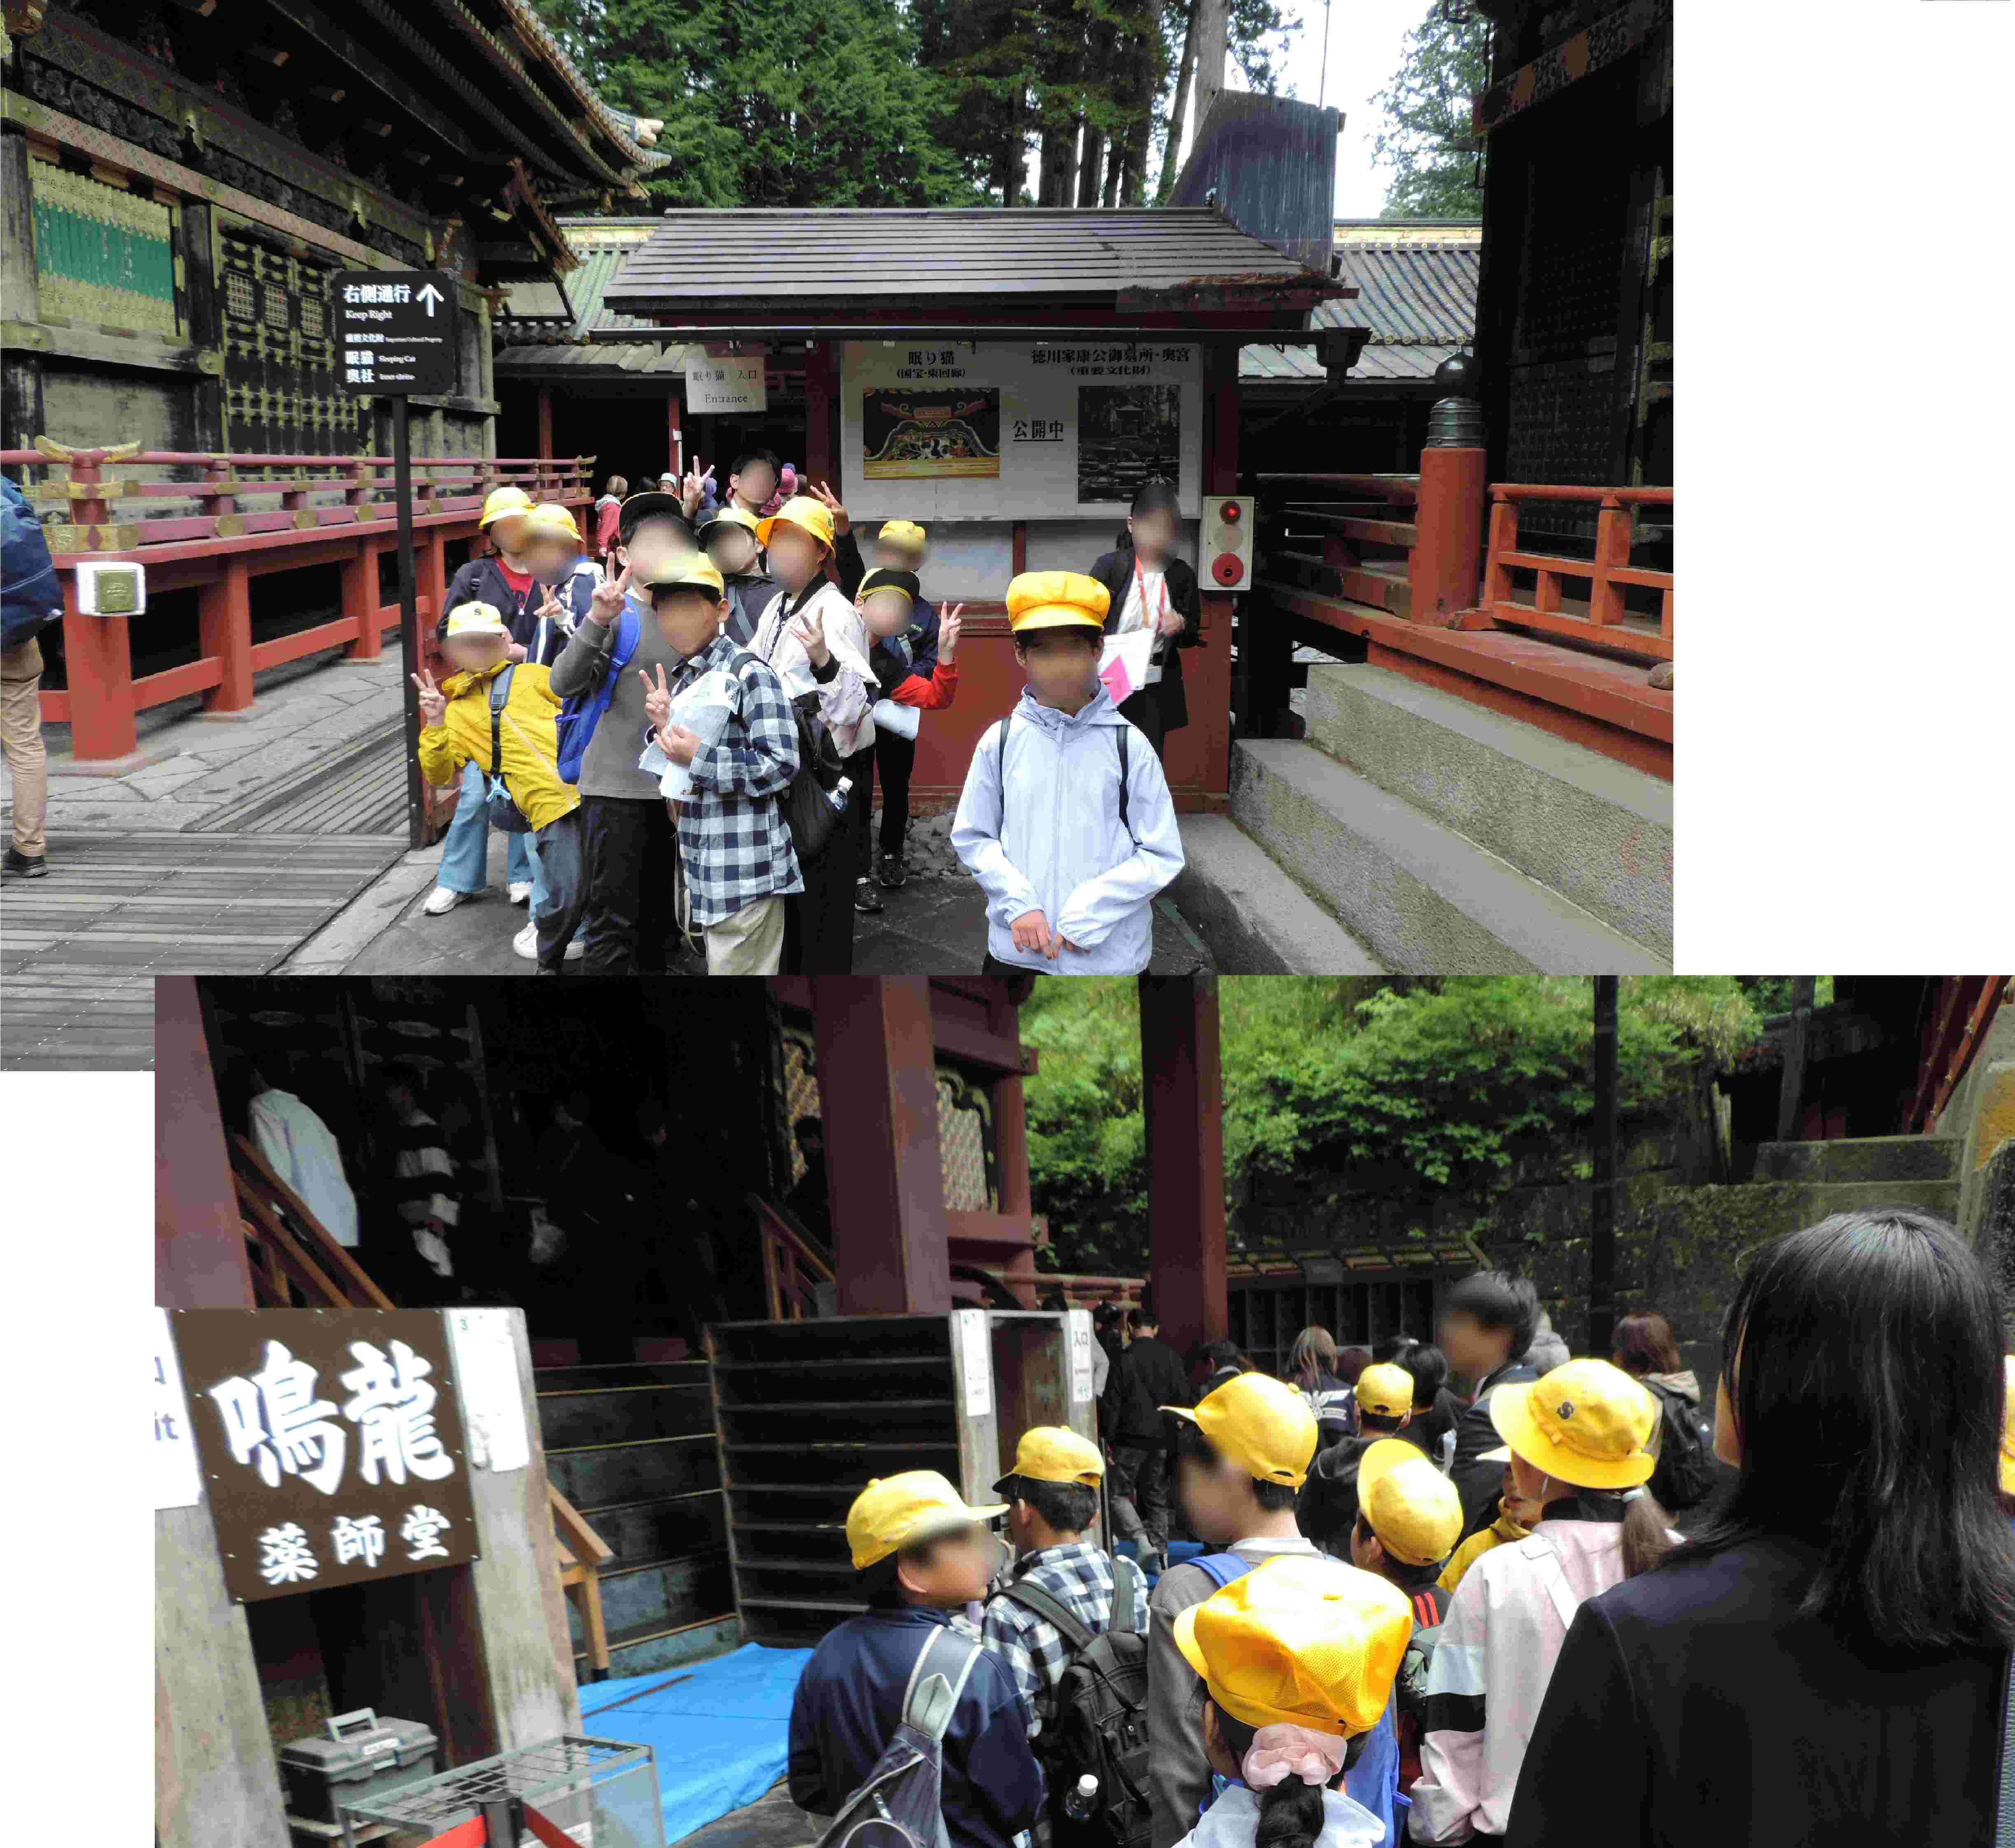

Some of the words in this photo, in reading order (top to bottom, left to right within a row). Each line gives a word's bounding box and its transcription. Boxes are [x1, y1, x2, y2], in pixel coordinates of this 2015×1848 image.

[342, 284, 412, 303] 右側通行
[345, 310, 368, 321] Keep
[368, 310, 392, 321] Right
[908, 350, 955, 365] 眠り猫
[346, 369, 375, 383] 奥社
[693, 369, 725, 381] 眠り猫
[736, 369, 757, 380] 入口
[704, 394, 748, 403] Entrance
[1013, 420, 1064, 439] 公開中
[209, 1339, 455, 1495] 鳴龍
[259, 1505, 452, 1585] 薬師堂
